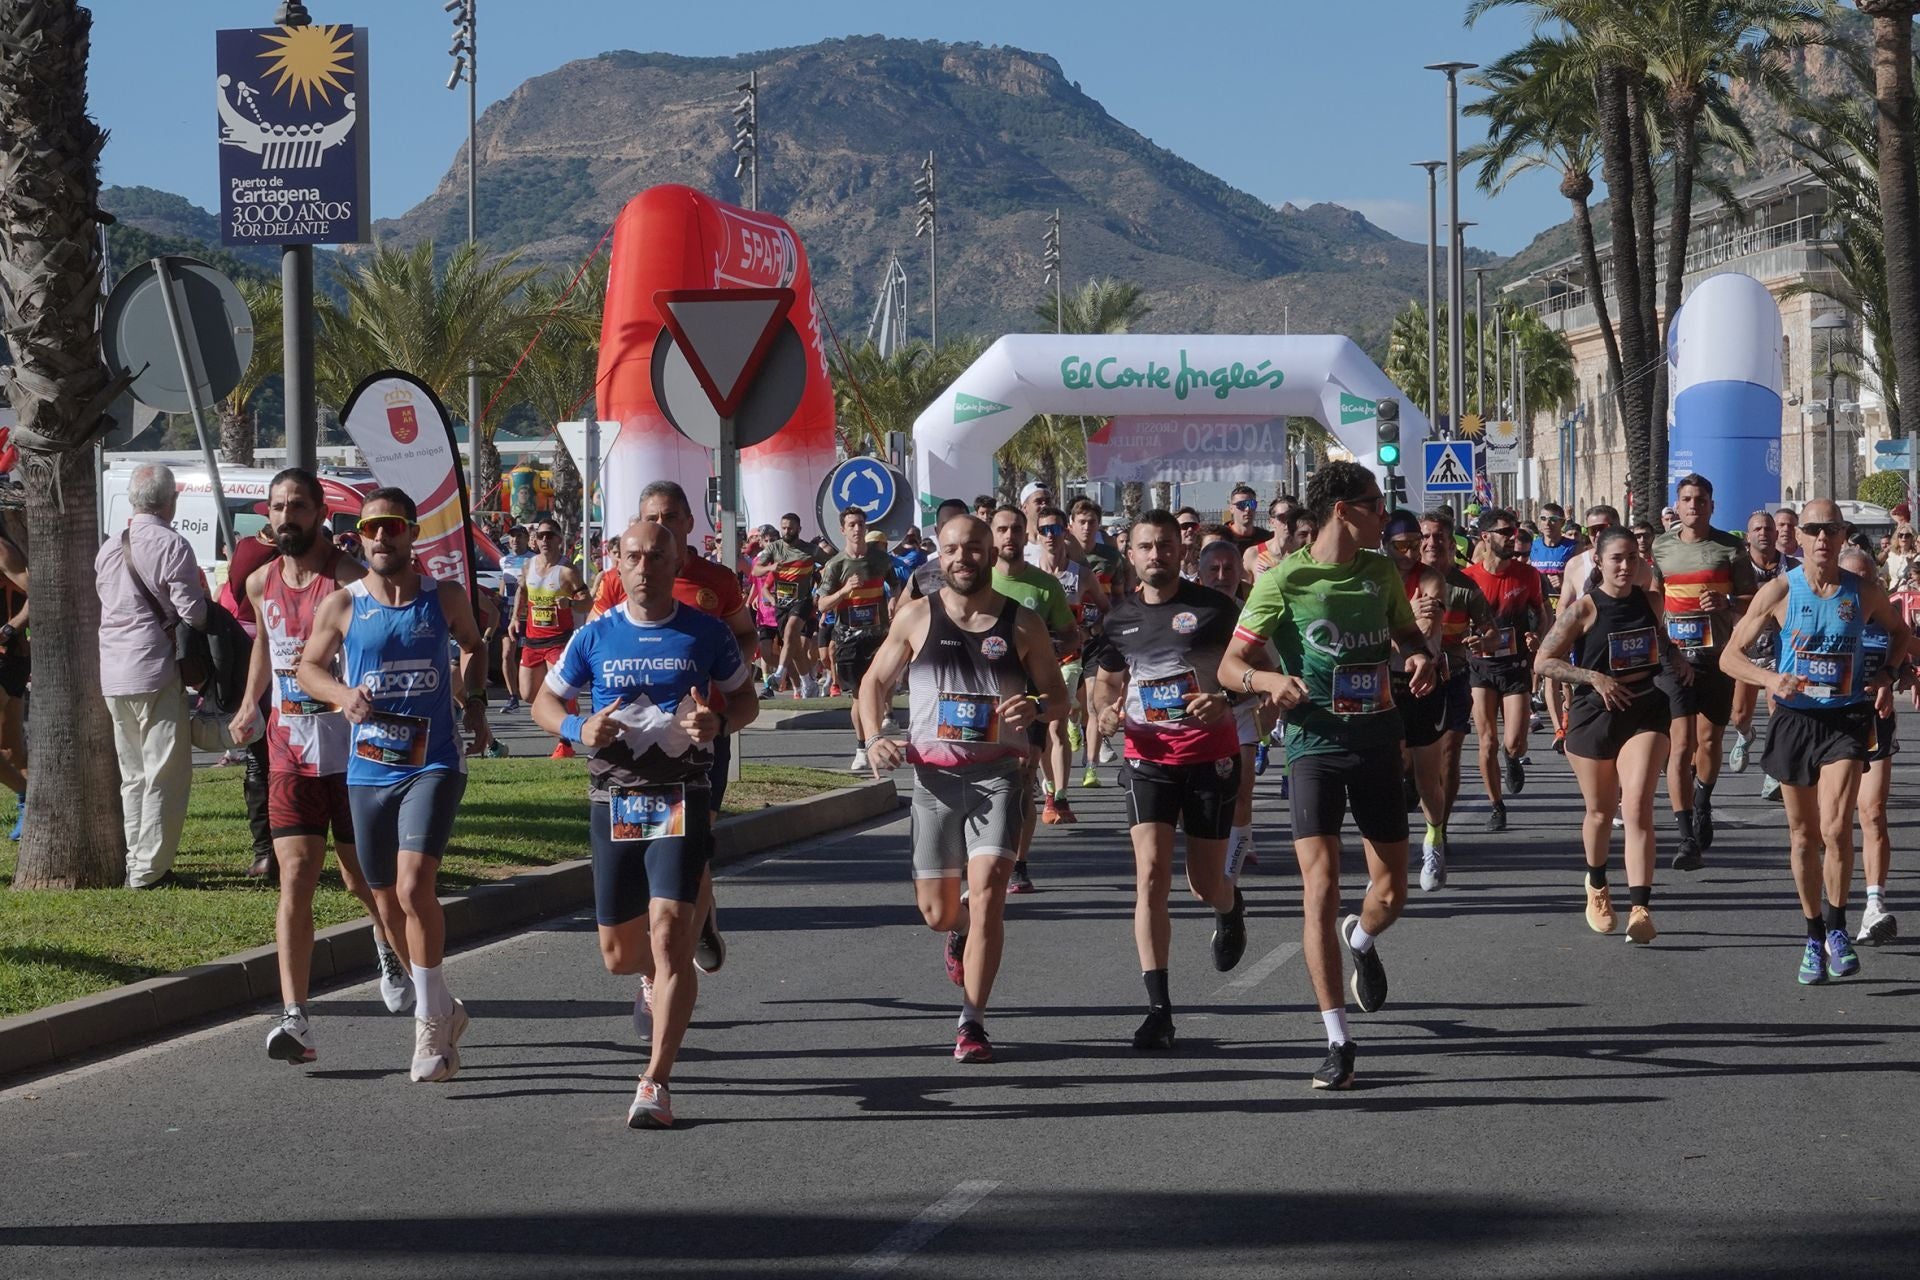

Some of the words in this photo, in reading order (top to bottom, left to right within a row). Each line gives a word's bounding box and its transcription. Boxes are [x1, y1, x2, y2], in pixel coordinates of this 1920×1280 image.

[231, 178, 267, 188] Puerto
[269, 176, 284, 187] de
[232, 188, 320, 206] Cartagena
[231, 204, 294, 226] 3.000
[295, 200, 352, 221] AÑOS
[232, 223, 262, 237] POR
[264, 221, 330, 236] DELANTE
[740, 227, 783, 277] SPAR
[1061, 356, 1093, 389] El
[1096, 356, 1171, 390] Corte
[1175, 349, 1285, 400] Inglés
[185, 482, 266, 496] AMBLANCIA
[182, 519, 209, 535] Roja
[535, 610, 550, 618] 2012
[1678, 623, 1697, 634] 540
[1622, 638, 1644, 651] 632
[603, 658, 698, 673] CARTAGENA
[1808, 661, 1837, 675] 565
[1351, 674, 1378, 690] 981
[1152, 684, 1180, 700] 429
[956, 702, 976, 719] 58
[622, 795, 668, 814] 1458
